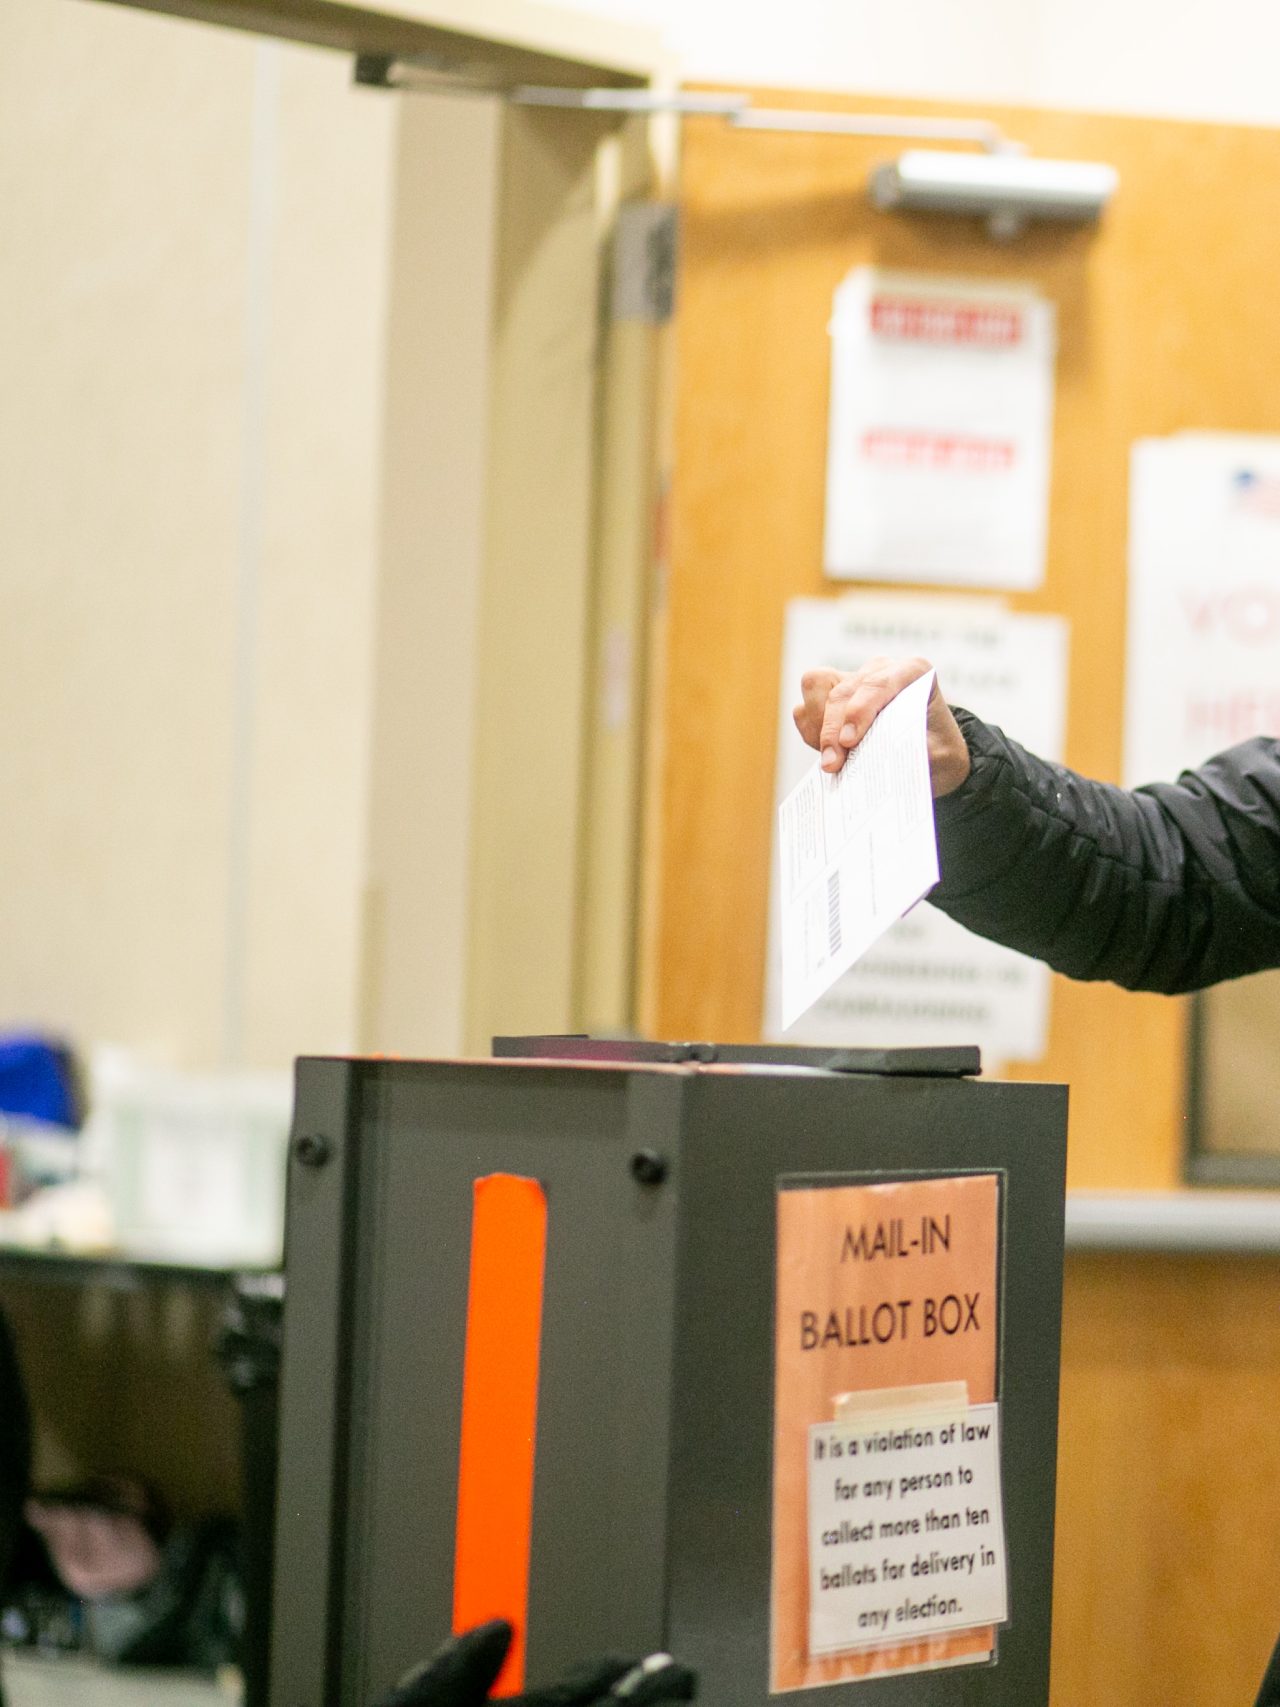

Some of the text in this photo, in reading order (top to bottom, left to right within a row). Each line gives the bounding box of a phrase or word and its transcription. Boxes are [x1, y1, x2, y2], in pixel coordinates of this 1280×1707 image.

[840, 1214, 950, 1262] MAIL-IN
[800, 1292, 980, 1350] BALLOT BOX
[814, 1422, 990, 1460] It is a violation of law
[834, 1466, 973, 1502] for any person to
[822, 1507, 989, 1547] collect more than ten
[820, 1545, 995, 1591] ballots for delivery in
[858, 1594, 963, 1631] any election.
